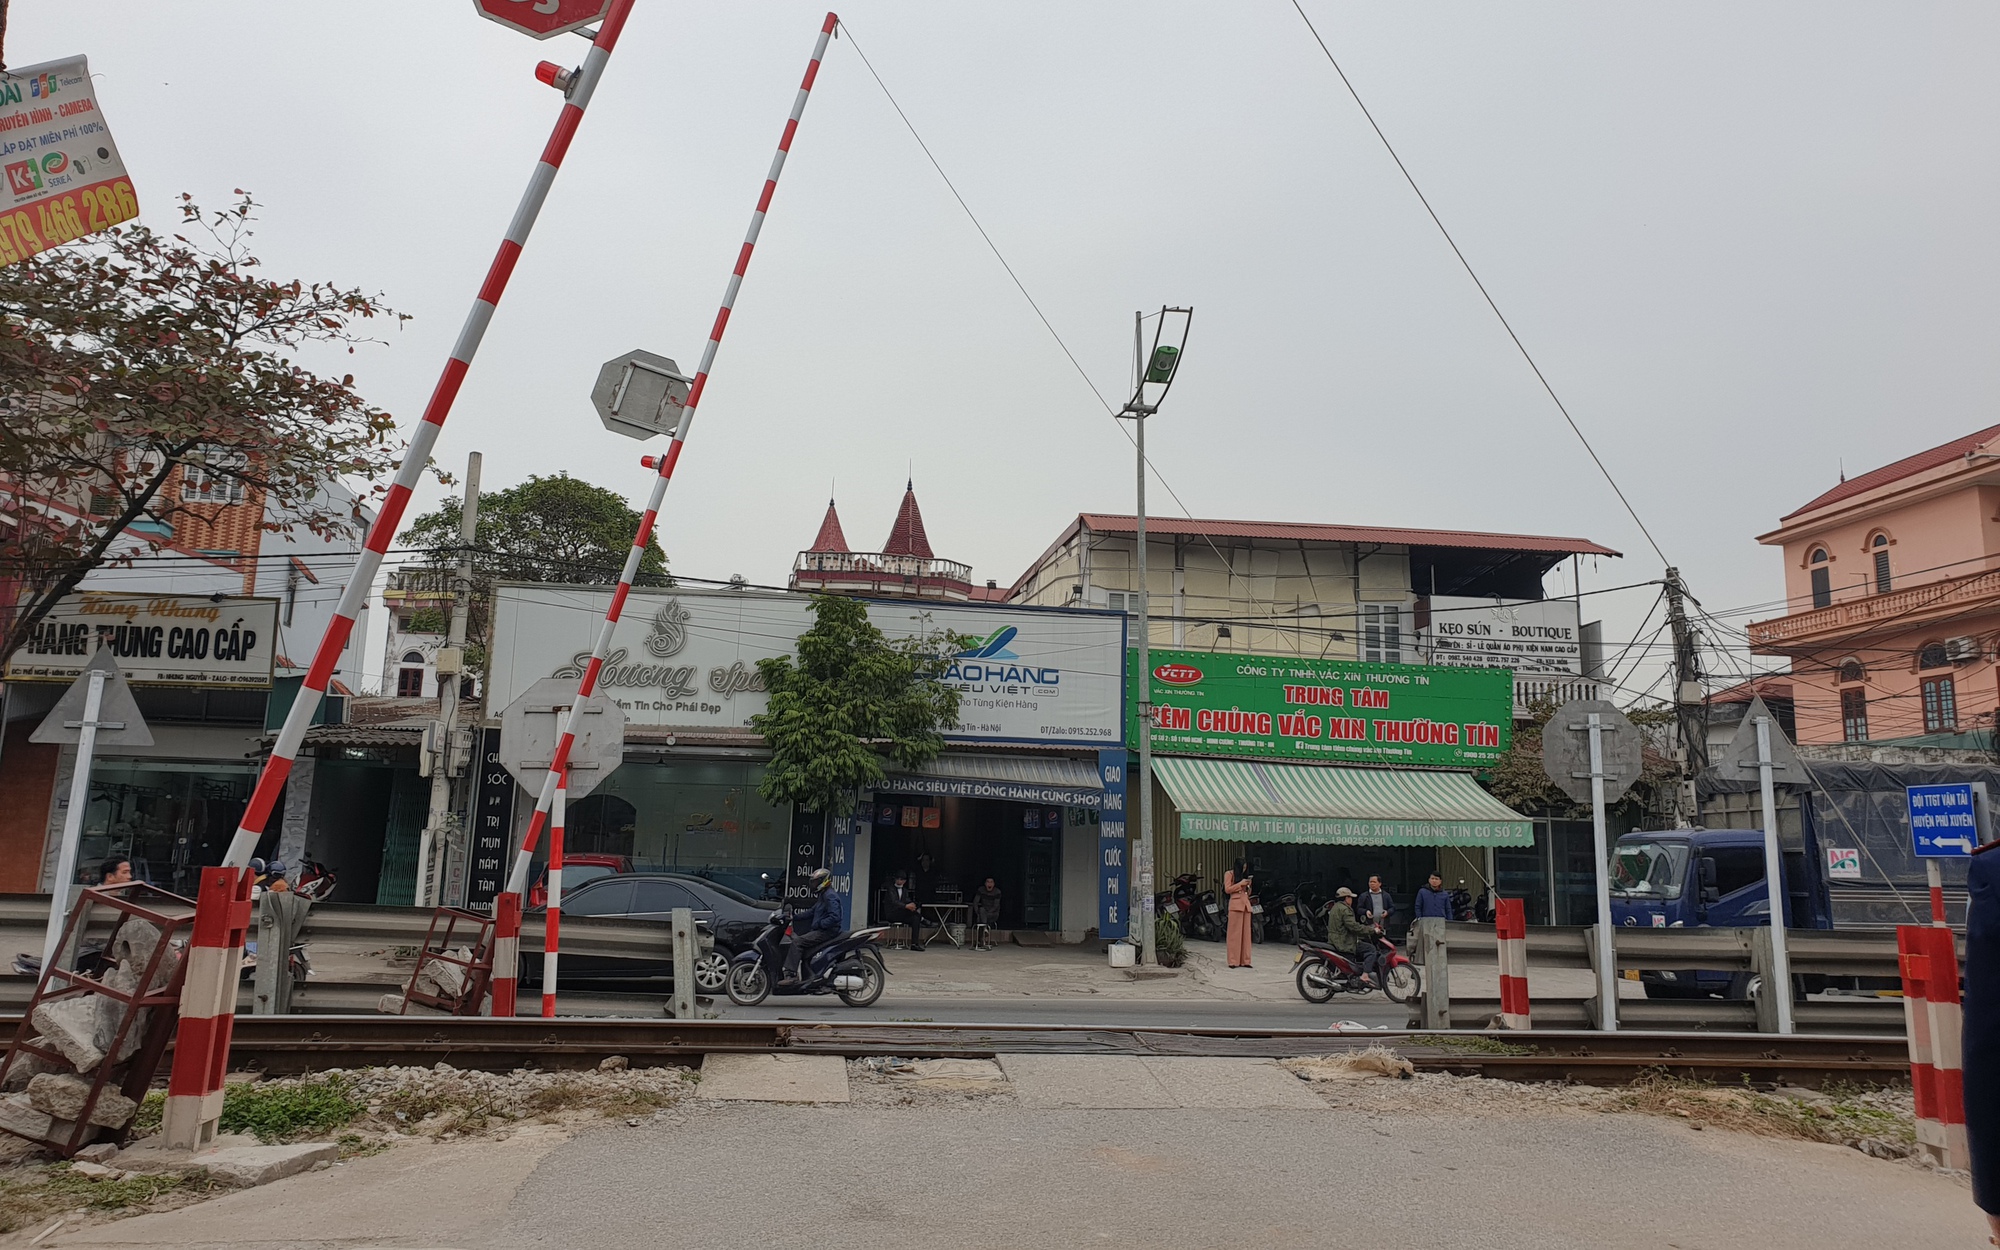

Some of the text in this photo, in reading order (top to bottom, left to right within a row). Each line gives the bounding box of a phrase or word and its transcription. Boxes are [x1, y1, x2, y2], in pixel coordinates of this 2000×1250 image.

[30, 74, 57, 98] FPT
[60, 76, 83, 88] Telecom
[29, 107, 53, 124] HÌNH
[58, 97, 94, 118] CAMERA
[18, 137, 37, 152] ĐẶT
[39, 131, 62, 146] MIỄN
[79, 121, 103, 135] 100%
[11, 166, 37, 189] K+
[37, 196, 85, 245] 466
[82, 181, 138, 231] 286
[147, 599, 220, 623] Nhung
[27, 615, 256, 661] HÀNG THÙNG CAO CẤP
[1439, 620, 1572, 640] KẸO SÚN BOUTIQUE
[1540, 645, 1553, 653] NAM
[1555, 645, 1565, 653] CAO
[709, 659, 769, 700] Spa
[1160, 667, 1196, 679] VCTT
[1236, 663, 1266, 676] CÔNG
[1271, 667, 1285, 678] TY
[1288, 668, 1315, 679] TNHH
[1365, 671, 1410, 685] THƯỜNG
[1414, 673, 1429, 686] TÍN
[990, 683, 1031, 697] VIỆT
[1283, 684, 1390, 709] TRUNG TÂM
[653, 701, 673, 712] Cho
[676, 701, 698, 713] Phái
[700, 702, 721, 714] Đẹp
[973, 697, 1038, 711] Từng Kiện Hàng
[981, 723, 989, 732] Hà
[990, 723, 1002, 733] Nội
[1040, 725, 1112, 737] ĐT/Zalo: 0915.252.968
[1197, 705, 1272, 735] CHỦNG
[1277, 708, 1322, 738] VẮC
[1329, 716, 1366, 741] XIN
[1373, 718, 1459, 746] THƯỜNG
[1464, 720, 1499, 747] TÍN
[487, 771, 508, 785] SÓC
[1105, 765, 1121, 783] GIAO
[893, 777, 924, 791] HÀNG
[926, 779, 948, 793] SIÊU
[949, 780, 973, 796] VIỆT
[974, 780, 1006, 797] ĐỒNG
[1008, 783, 1039, 799] HÀNH
[1042, 787, 1071, 803] CÙNG
[1072, 793, 1100, 806] SHOP
[1103, 789, 1122, 811] HÀNG
[1912, 789, 1968, 809] ĐỘI TTGT VẬN TẢI
[487, 815, 500, 829] TRỊ
[1101, 820, 1125, 838] NHANH
[1187, 817, 1229, 831] TRUNG
[1233, 817, 1260, 833] TÂM
[1264, 818, 1296, 834] TIÊM
[1299, 819, 1342, 835] CHỦNG
[1345, 820, 1370, 836] VẮC
[1373, 824, 1394, 837] XIN
[1397, 822, 1448, 838] THƯỜNG
[1475, 825, 1490, 838] CƠ
[1494, 822, 1511, 838] SỞ
[1515, 825, 1523, 838] 2
[1912, 812, 1973, 829] HUYỆN PHÚ XUYÊN
[481, 837, 501, 851] MỤN
[1296, 834, 1386, 844] Hotline: 1900252560
[798, 842, 814, 858] GỘI
[835, 842, 845, 863] VÀ
[1104, 846, 1122, 867] CƯỚC
[479, 856, 498, 870] NÁM
[478, 877, 495, 892] TÀN
[839, 872, 850, 896] HỘ
[1107, 873, 1119, 895] PHÍ
[1109, 901, 1118, 924] RẺ
